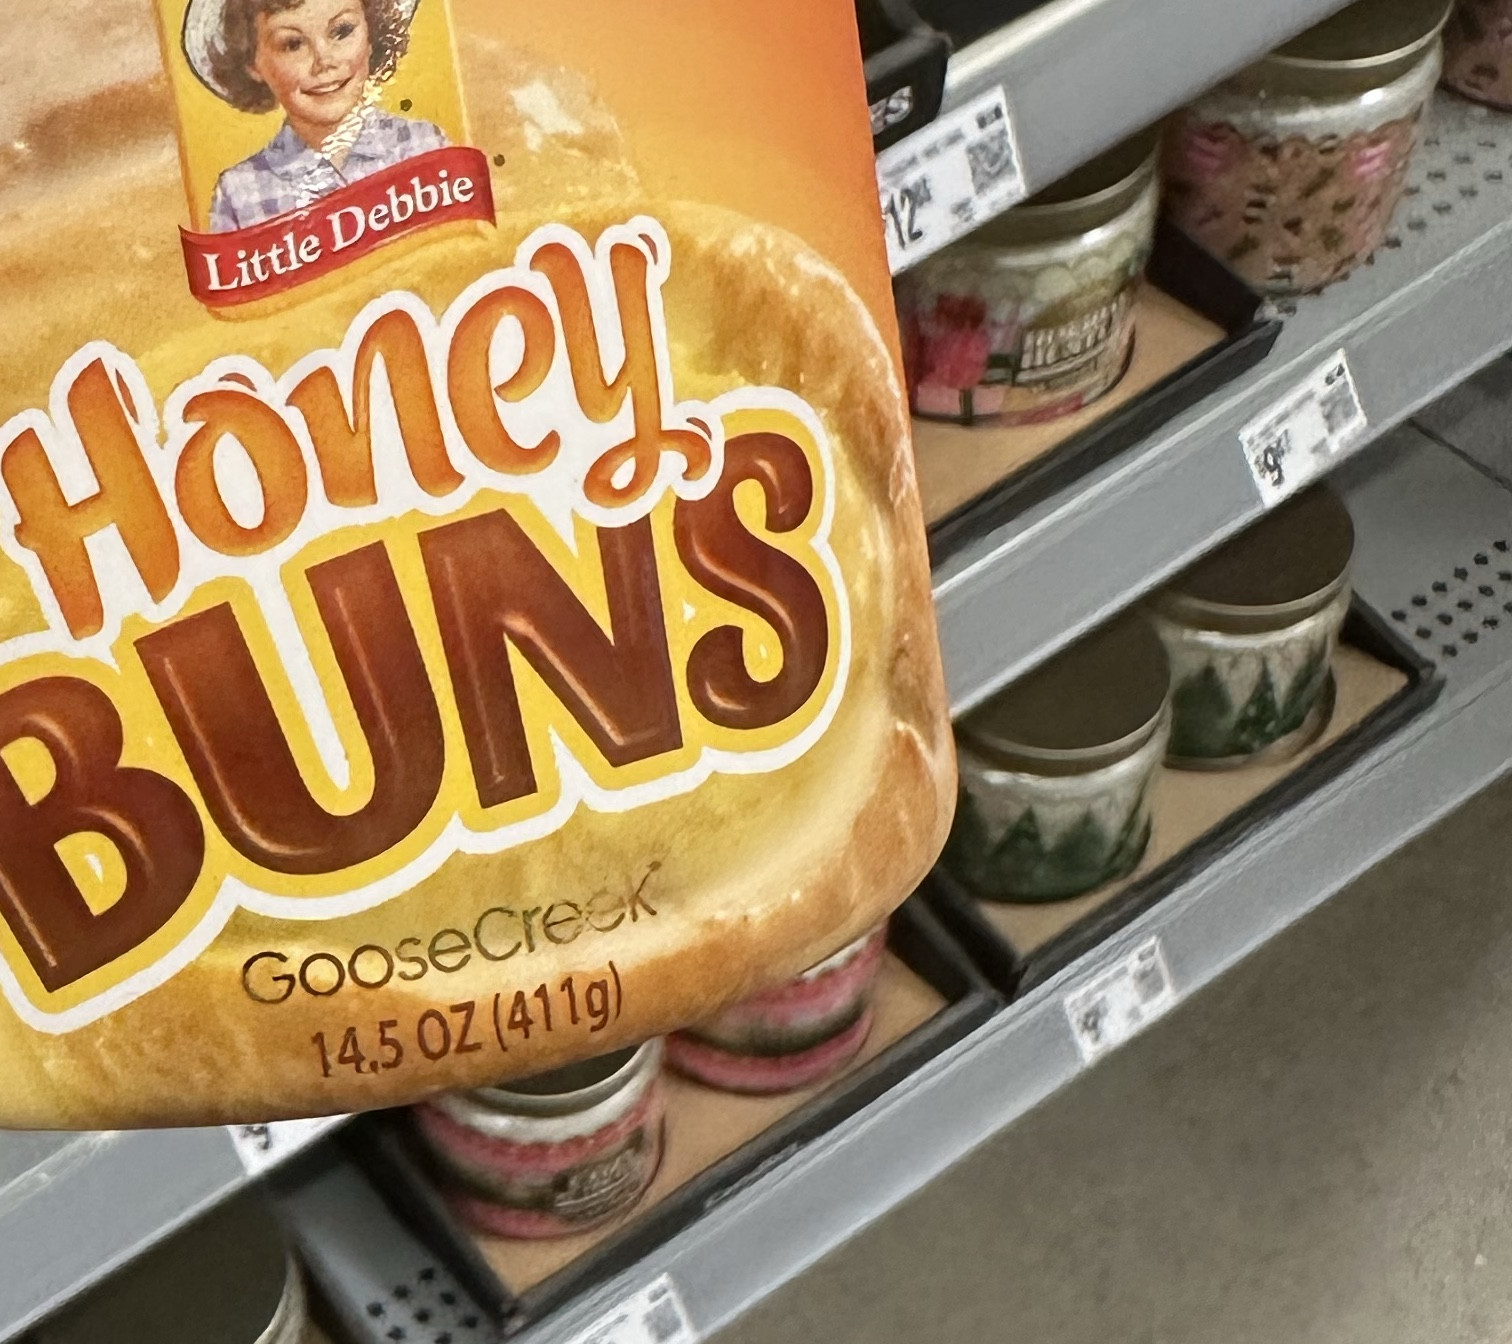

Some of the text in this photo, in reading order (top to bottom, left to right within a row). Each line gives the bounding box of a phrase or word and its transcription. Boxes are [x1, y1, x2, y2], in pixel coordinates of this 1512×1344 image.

[202, 168, 476, 292] Little Debbie
[310, 959, 624, 1078] 14.5 OZ (411g)
